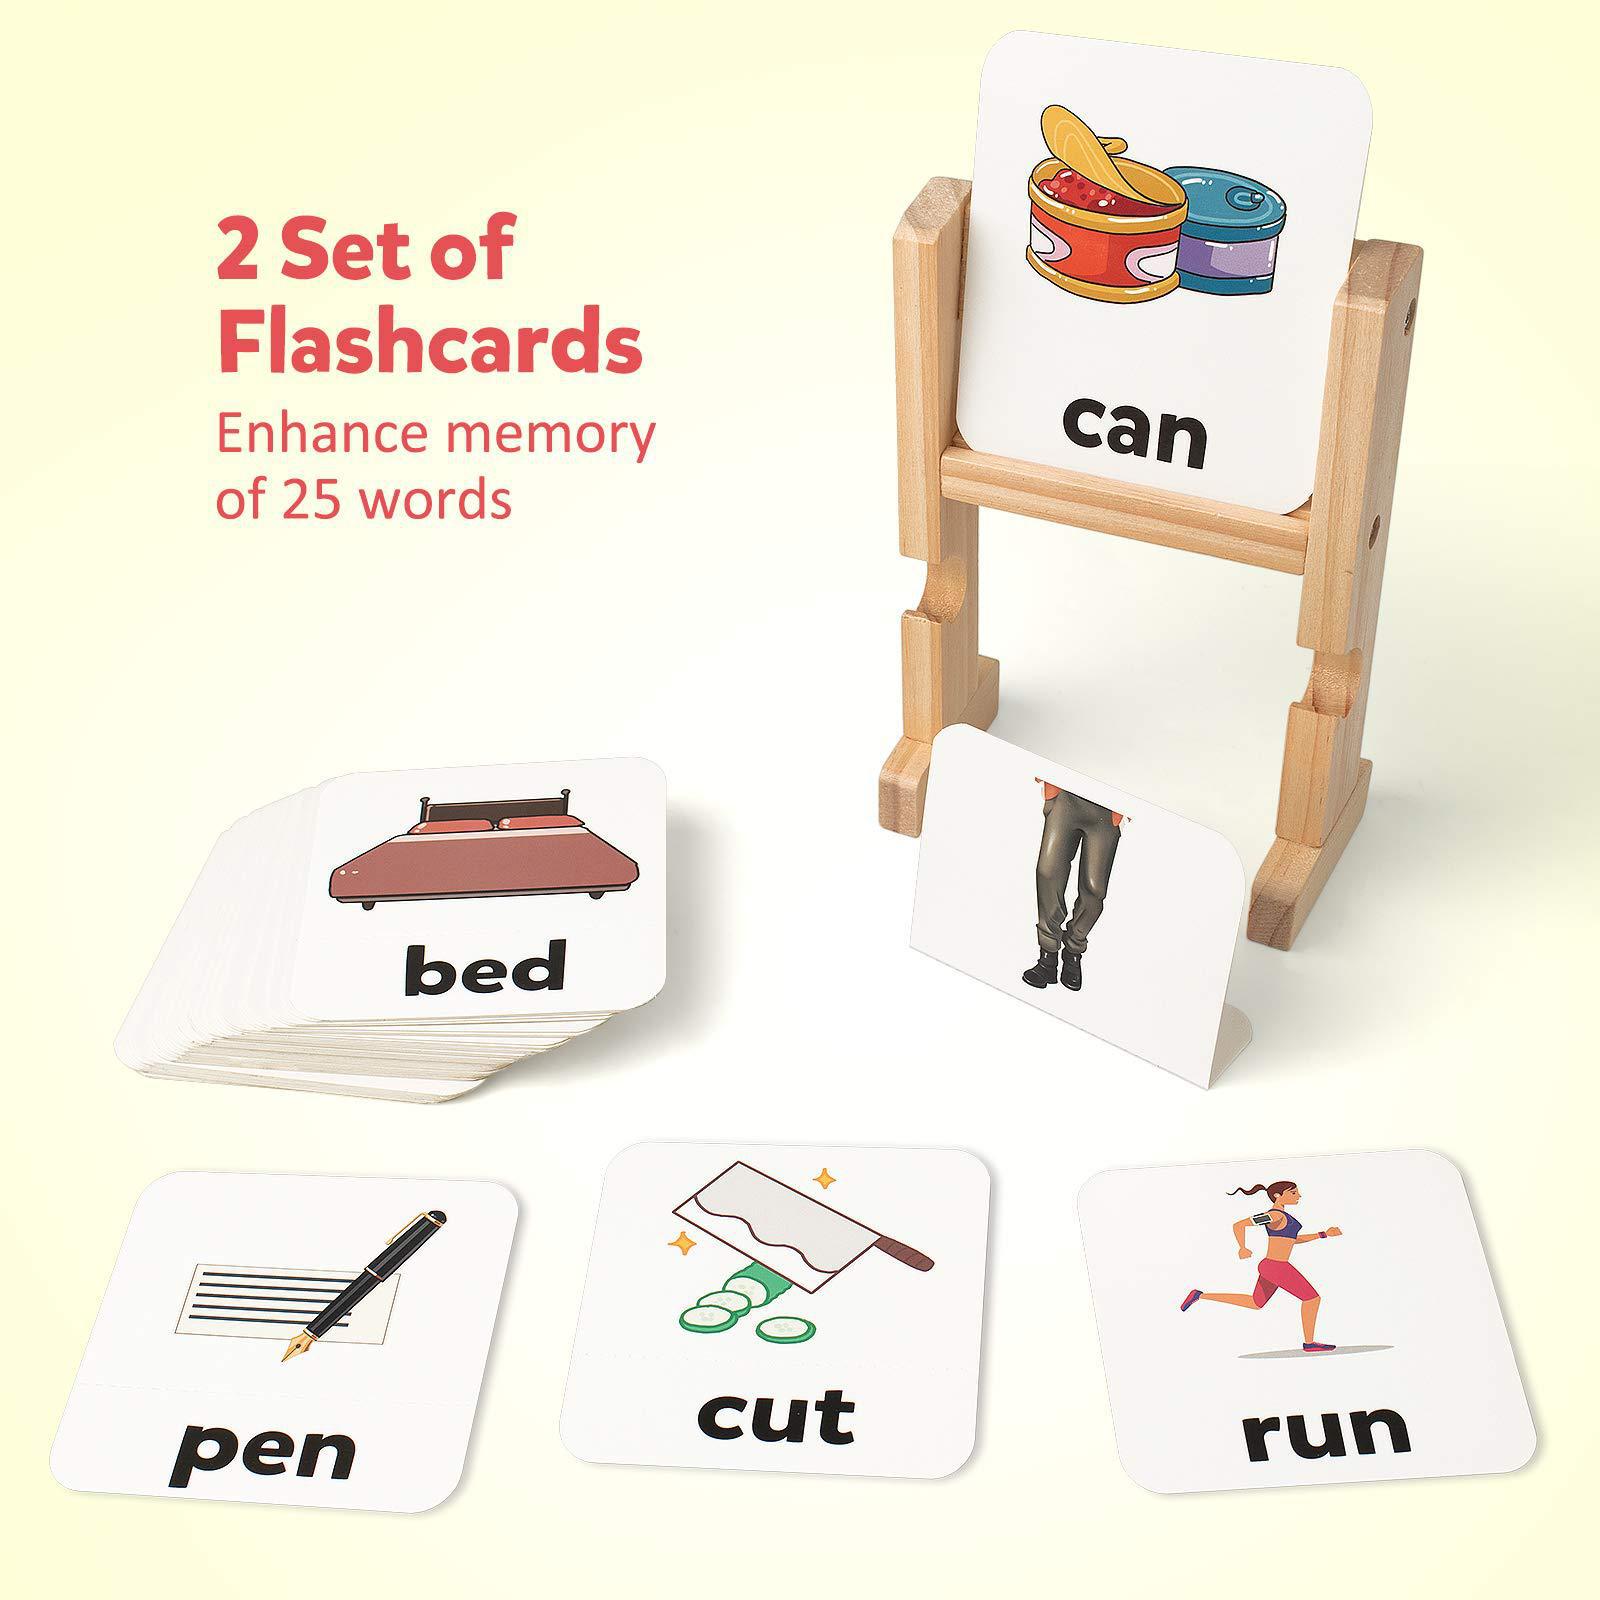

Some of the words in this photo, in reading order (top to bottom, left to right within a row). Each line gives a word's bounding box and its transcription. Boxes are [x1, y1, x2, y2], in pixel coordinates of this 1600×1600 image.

[1063, 398, 1207, 469] can
[405, 939, 567, 997] bed
[697, 1389, 856, 1446] cut
[1242, 1408, 1412, 1462] run
[168, 1425, 356, 1489] pen
